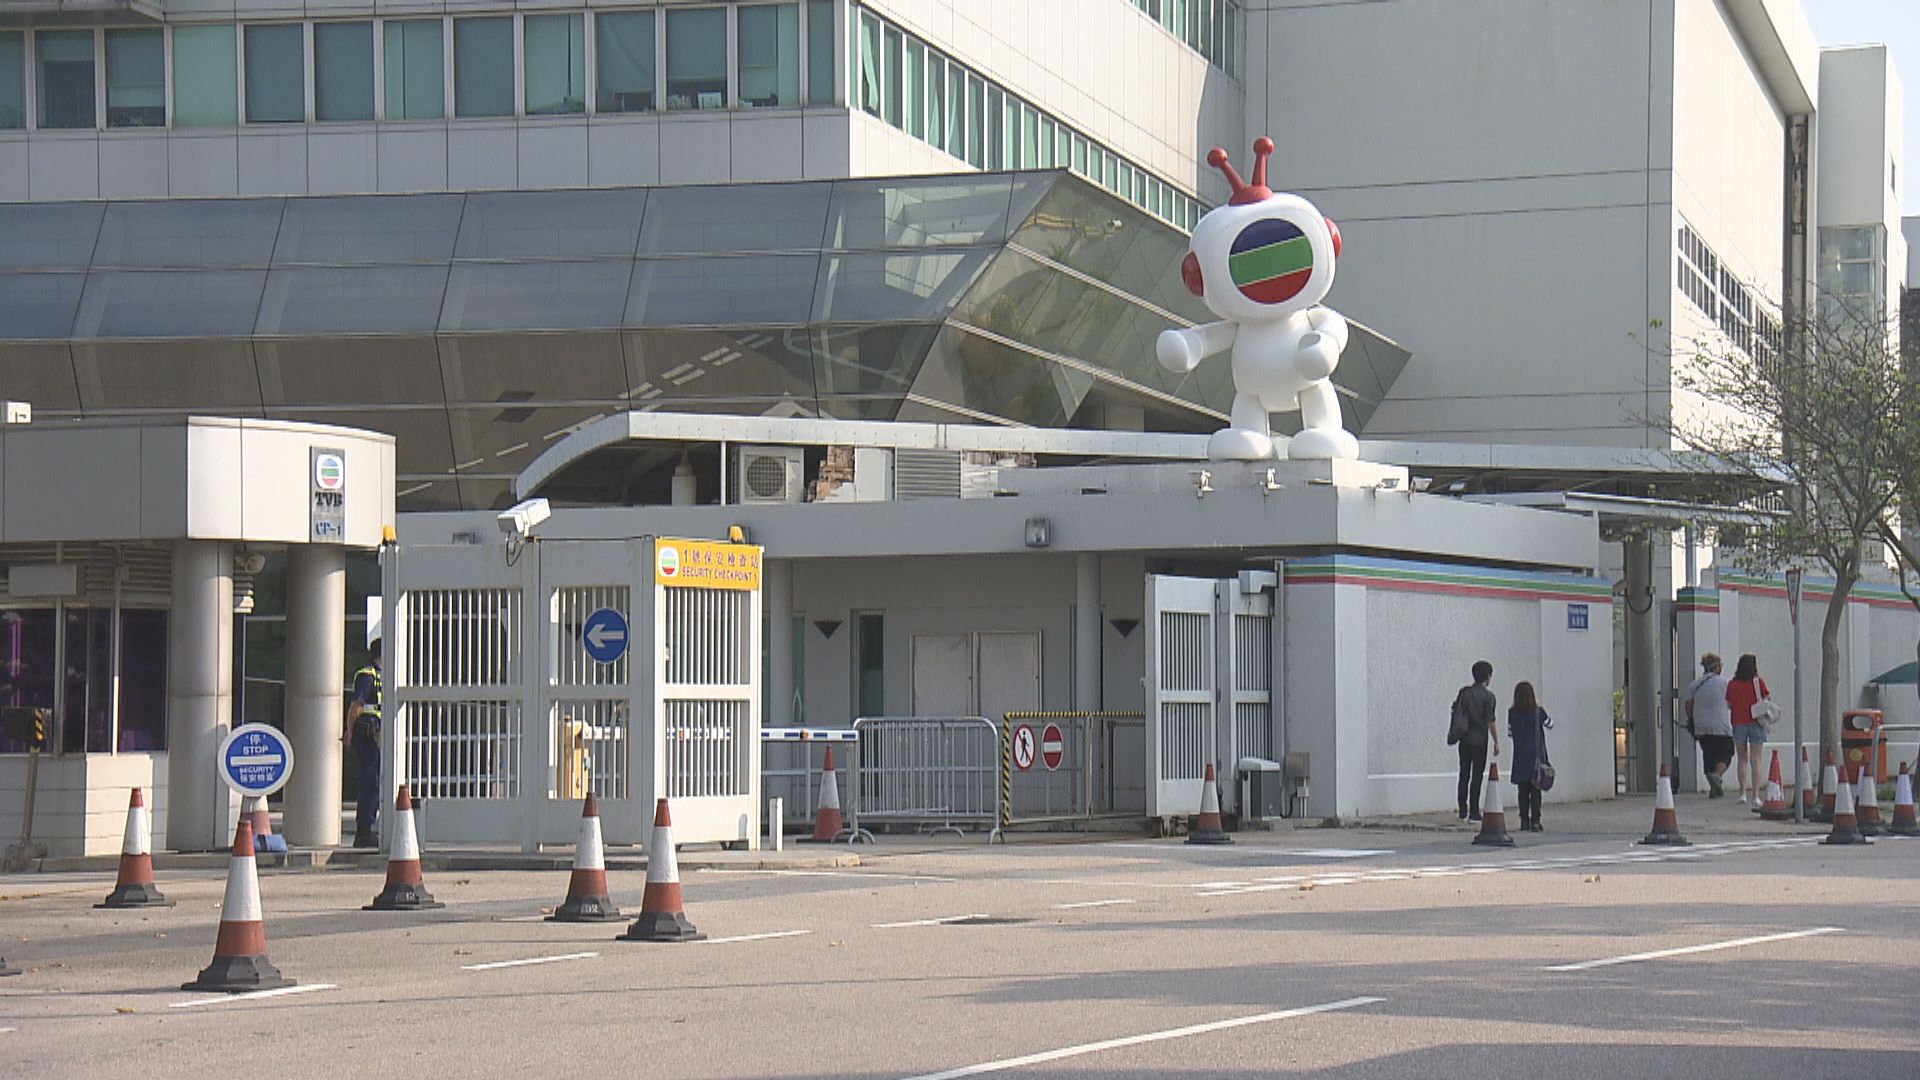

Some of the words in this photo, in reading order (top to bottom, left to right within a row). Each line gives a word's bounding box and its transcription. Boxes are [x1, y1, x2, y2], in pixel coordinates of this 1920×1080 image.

[315, 492, 342, 507] TVB
[682, 566, 712, 579] SECURITY
[714, 568, 752, 581] CHECKPOINT
[243, 745, 269, 755] STOP
